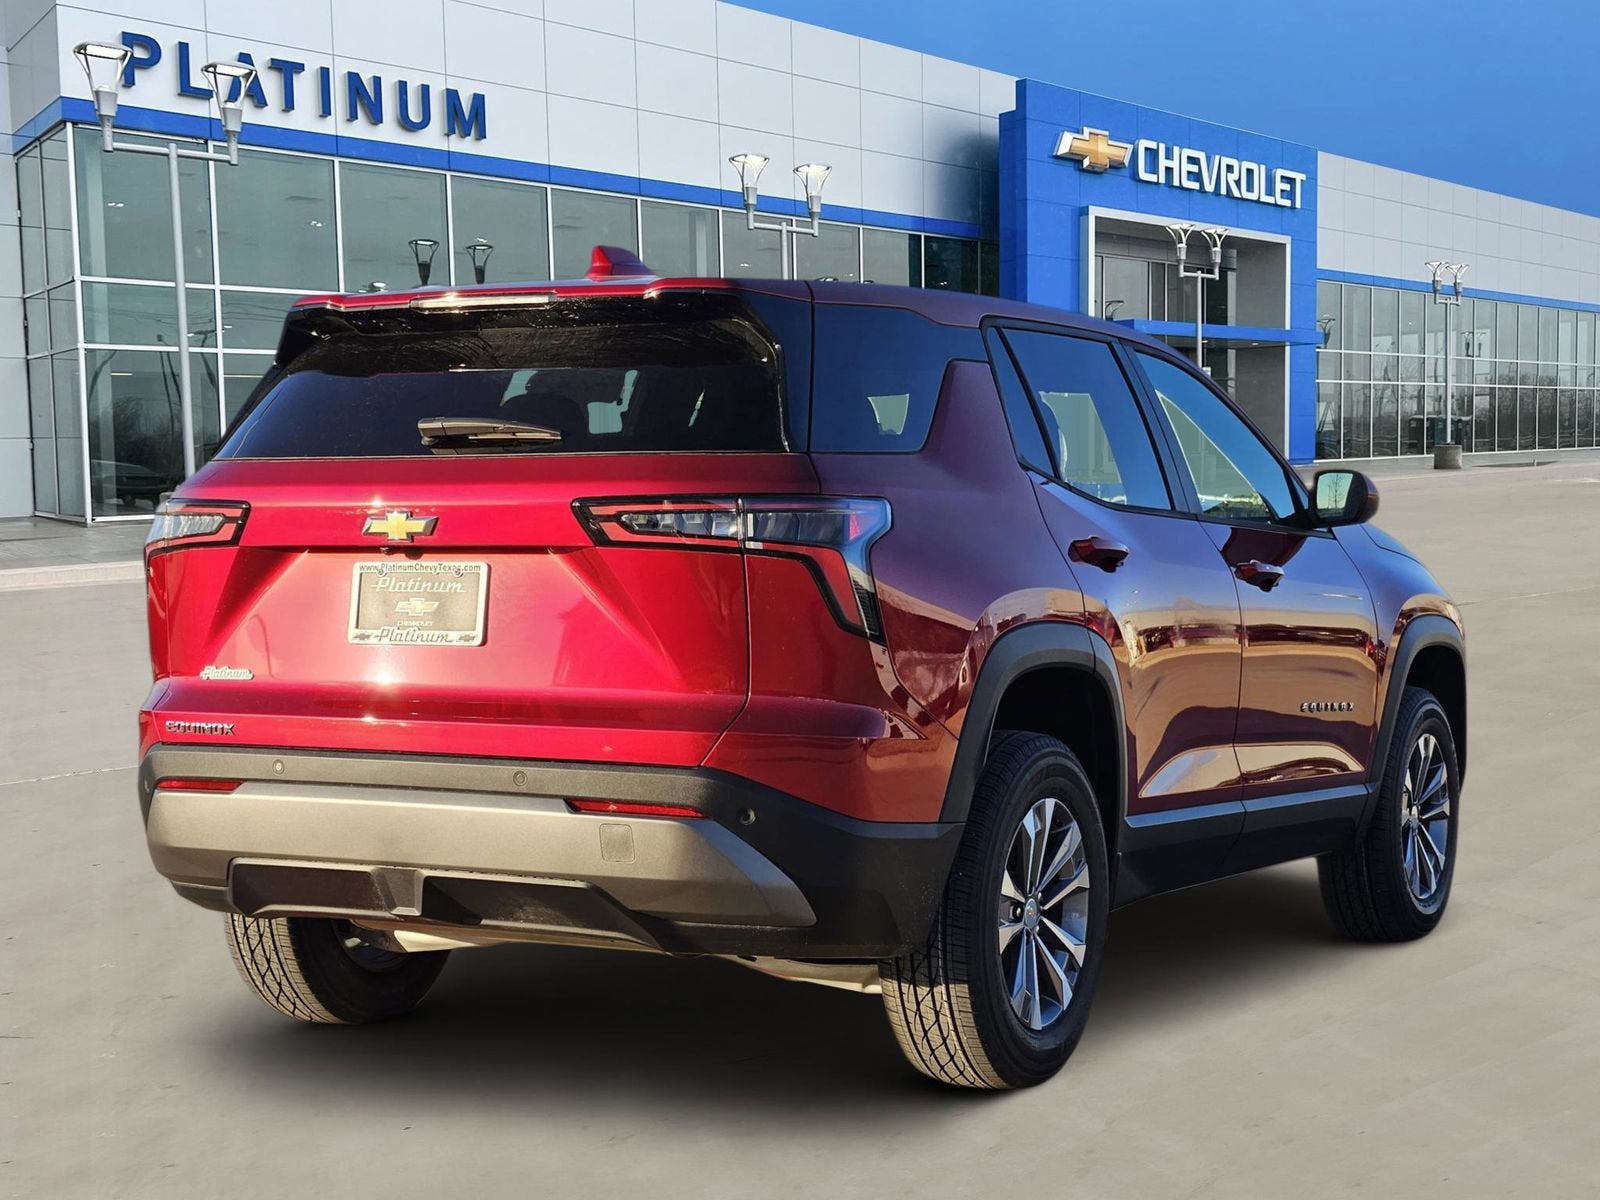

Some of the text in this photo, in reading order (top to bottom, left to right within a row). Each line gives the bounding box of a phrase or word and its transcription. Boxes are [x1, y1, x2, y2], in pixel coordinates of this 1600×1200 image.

[120, 31, 488, 140] PLATINUM
[1138, 139, 1306, 208] CHEVROLET
[371, 576, 467, 593] Platinum
[374, 627, 454, 643] Platinum
[201, 666, 252, 680] Platinum
[1300, 702, 1354, 712] EQUINOX
[165, 721, 235, 735] EQUINOX
